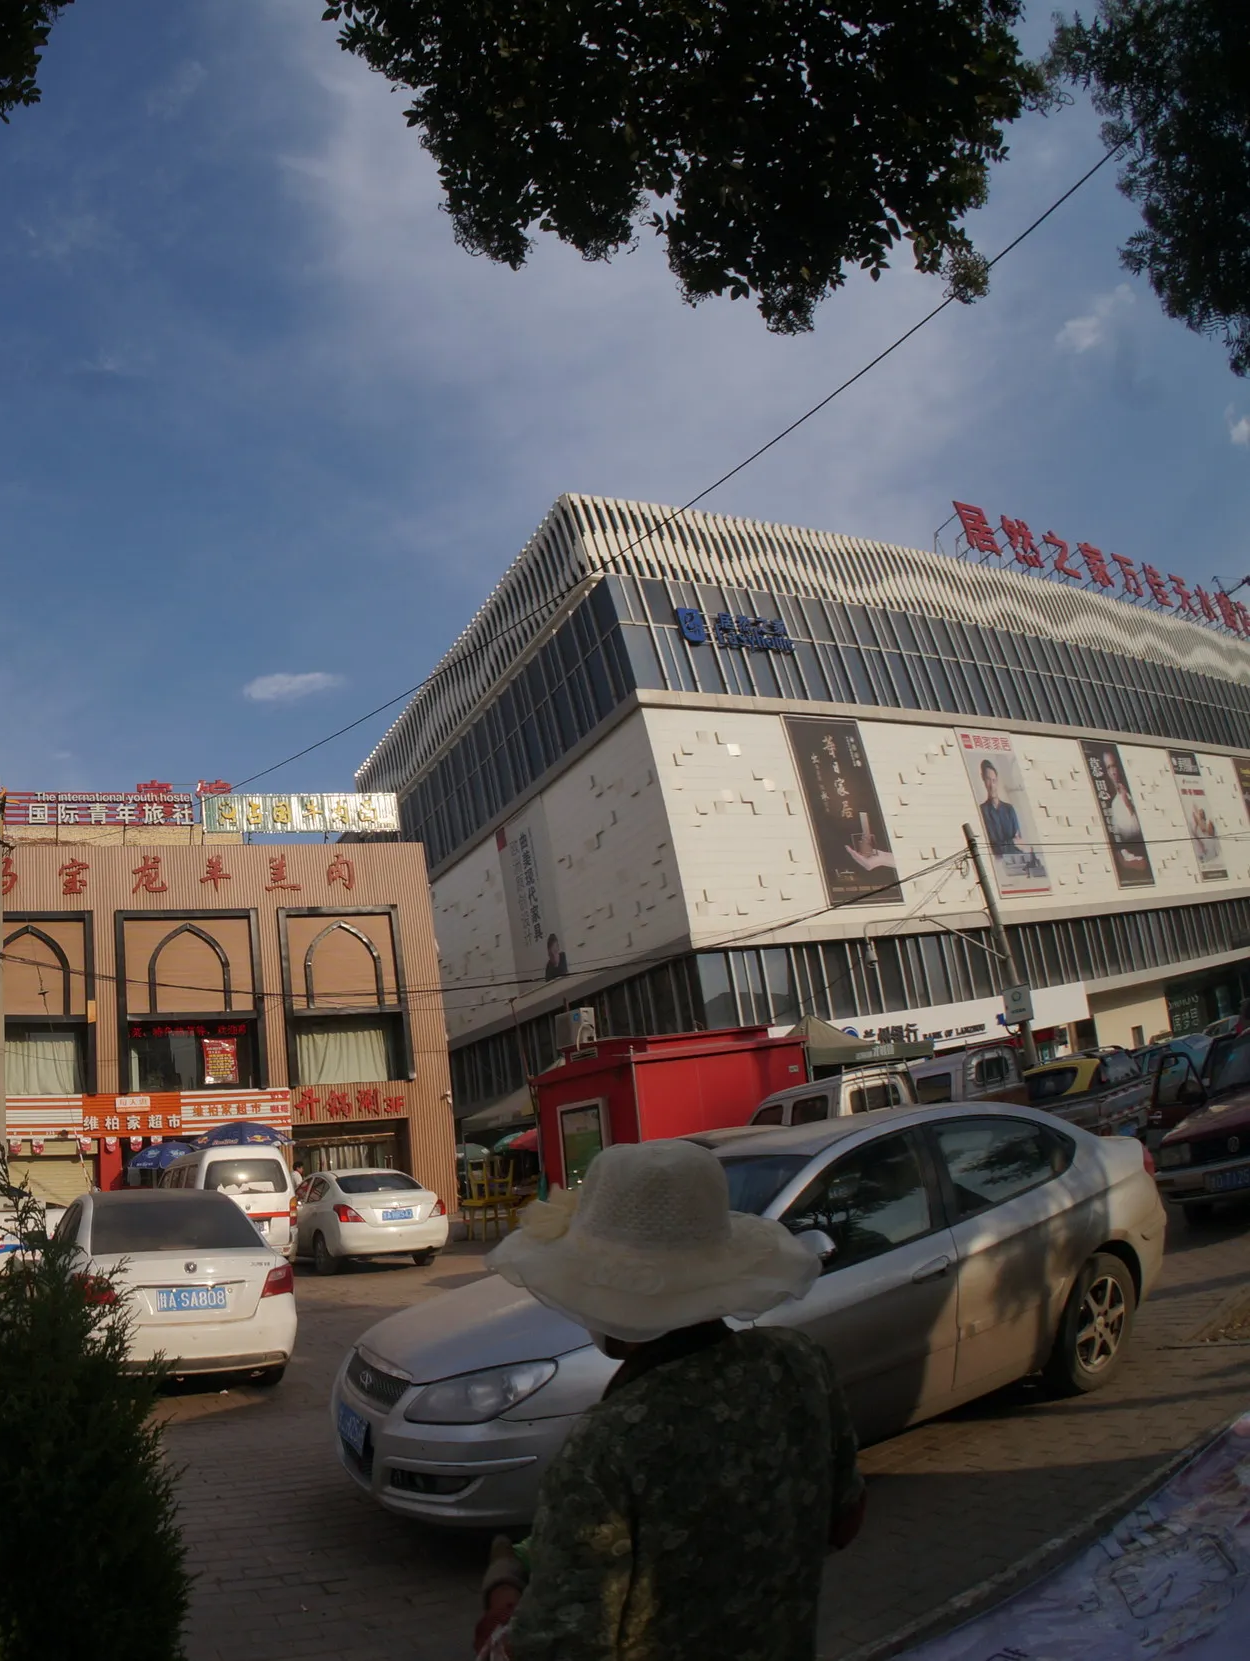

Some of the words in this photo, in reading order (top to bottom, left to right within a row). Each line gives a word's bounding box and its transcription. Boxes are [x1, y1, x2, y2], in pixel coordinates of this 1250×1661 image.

[36, 792, 57, 802] The
[58, 792, 125, 802] international
[127, 792, 158, 804] youth
[160, 792, 193, 802] hostel
[29, 803, 195, 826] 国际青年旅社
[193, 1103, 262, 1118] 维柏家超市
[83, 1114, 182, 1132] 维柏家超市
